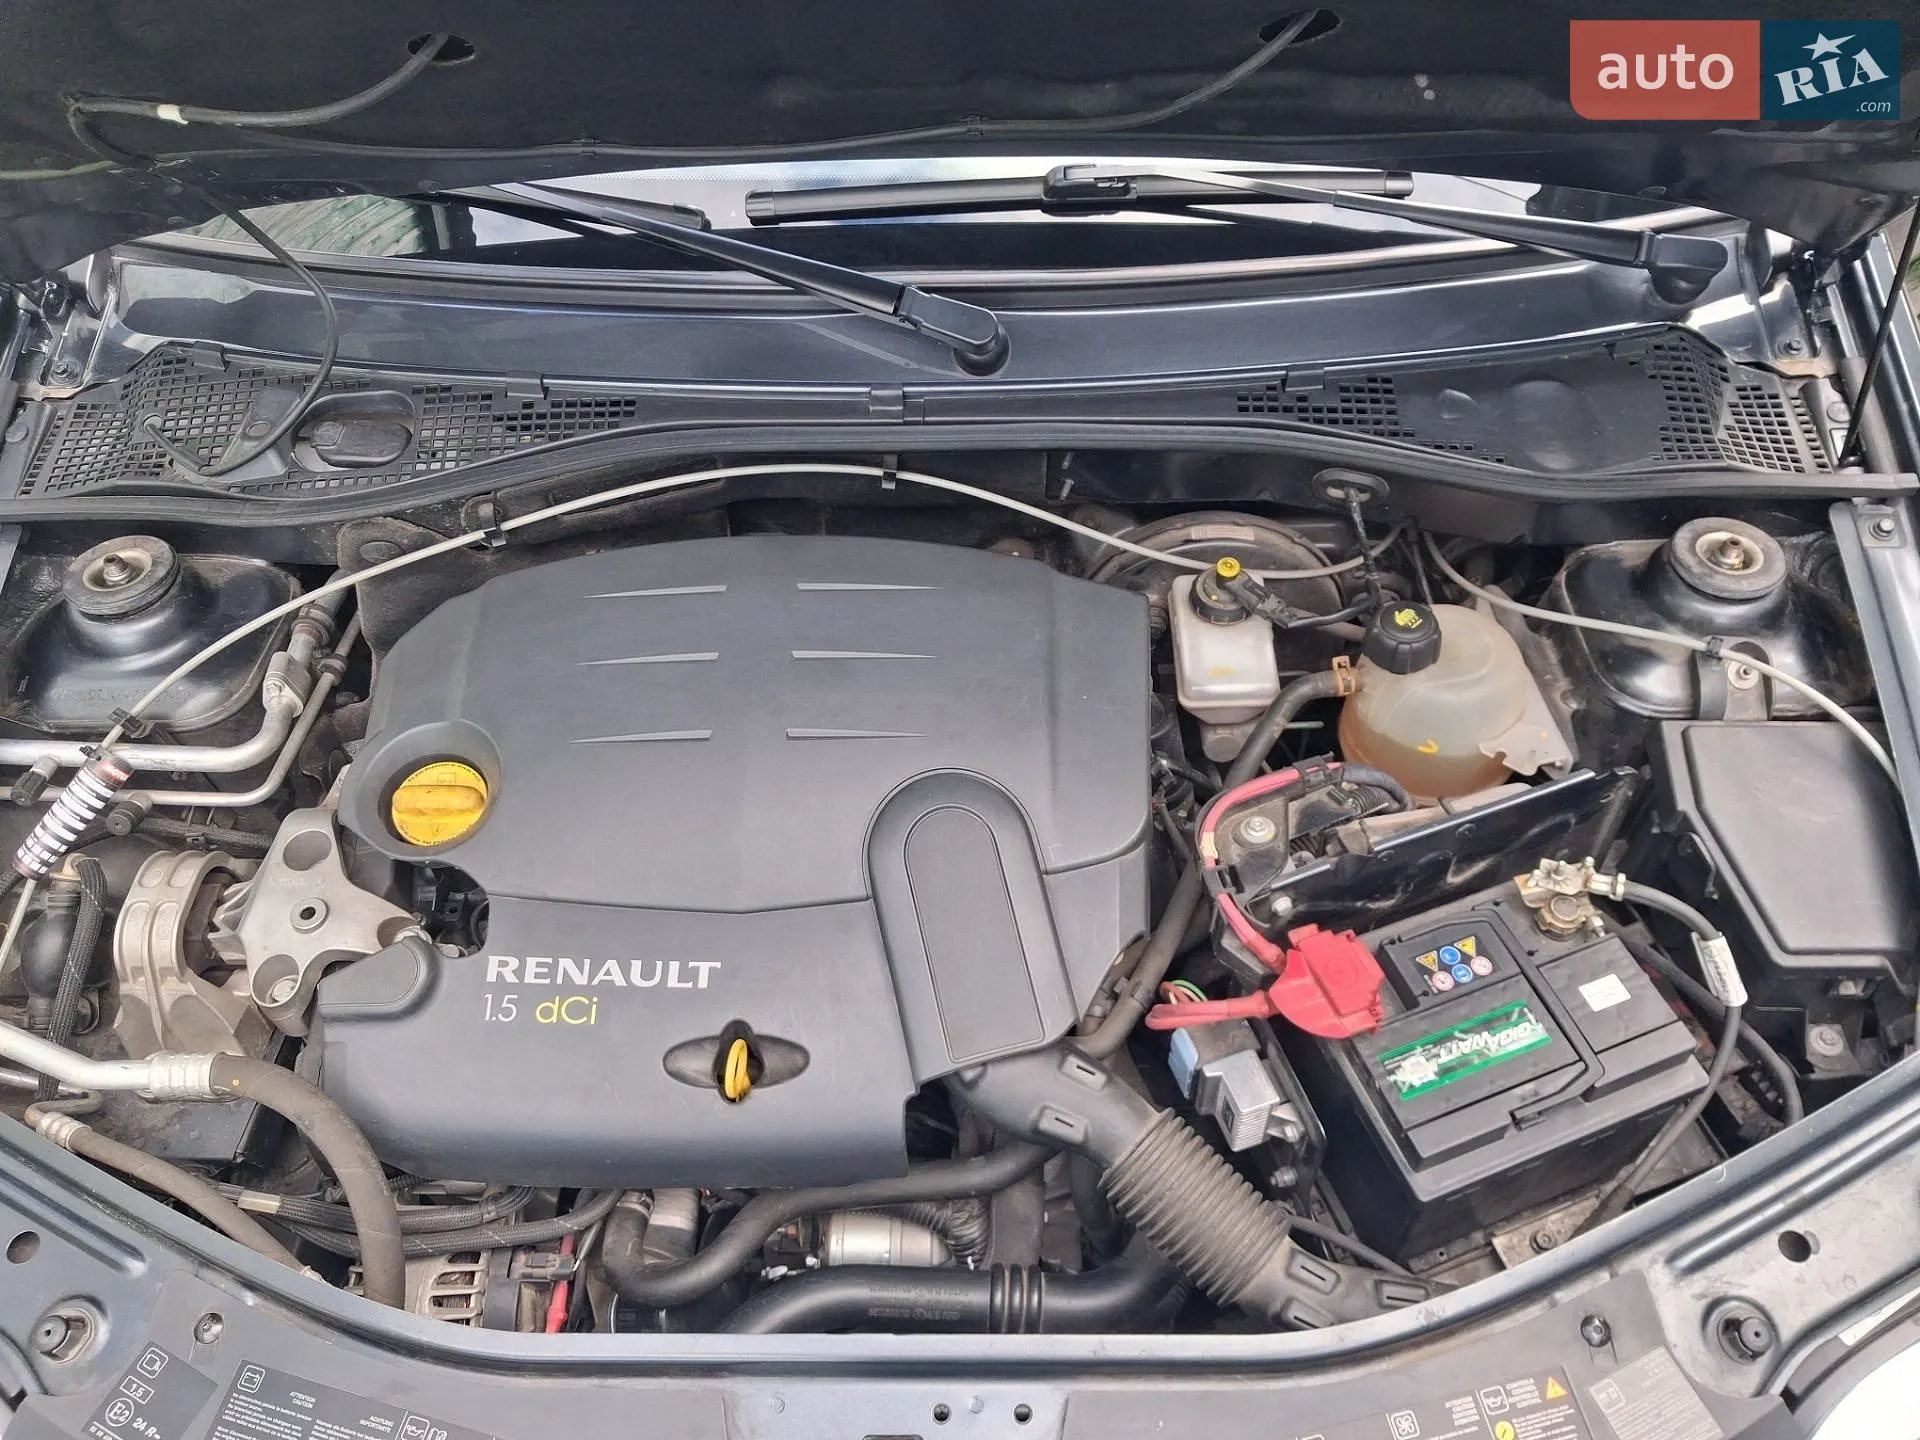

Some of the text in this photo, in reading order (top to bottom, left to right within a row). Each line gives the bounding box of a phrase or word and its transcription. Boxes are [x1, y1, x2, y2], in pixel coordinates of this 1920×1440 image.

[485, 955, 721, 989] RENAULT
[483, 993, 598, 1025] 1.5 dCi
